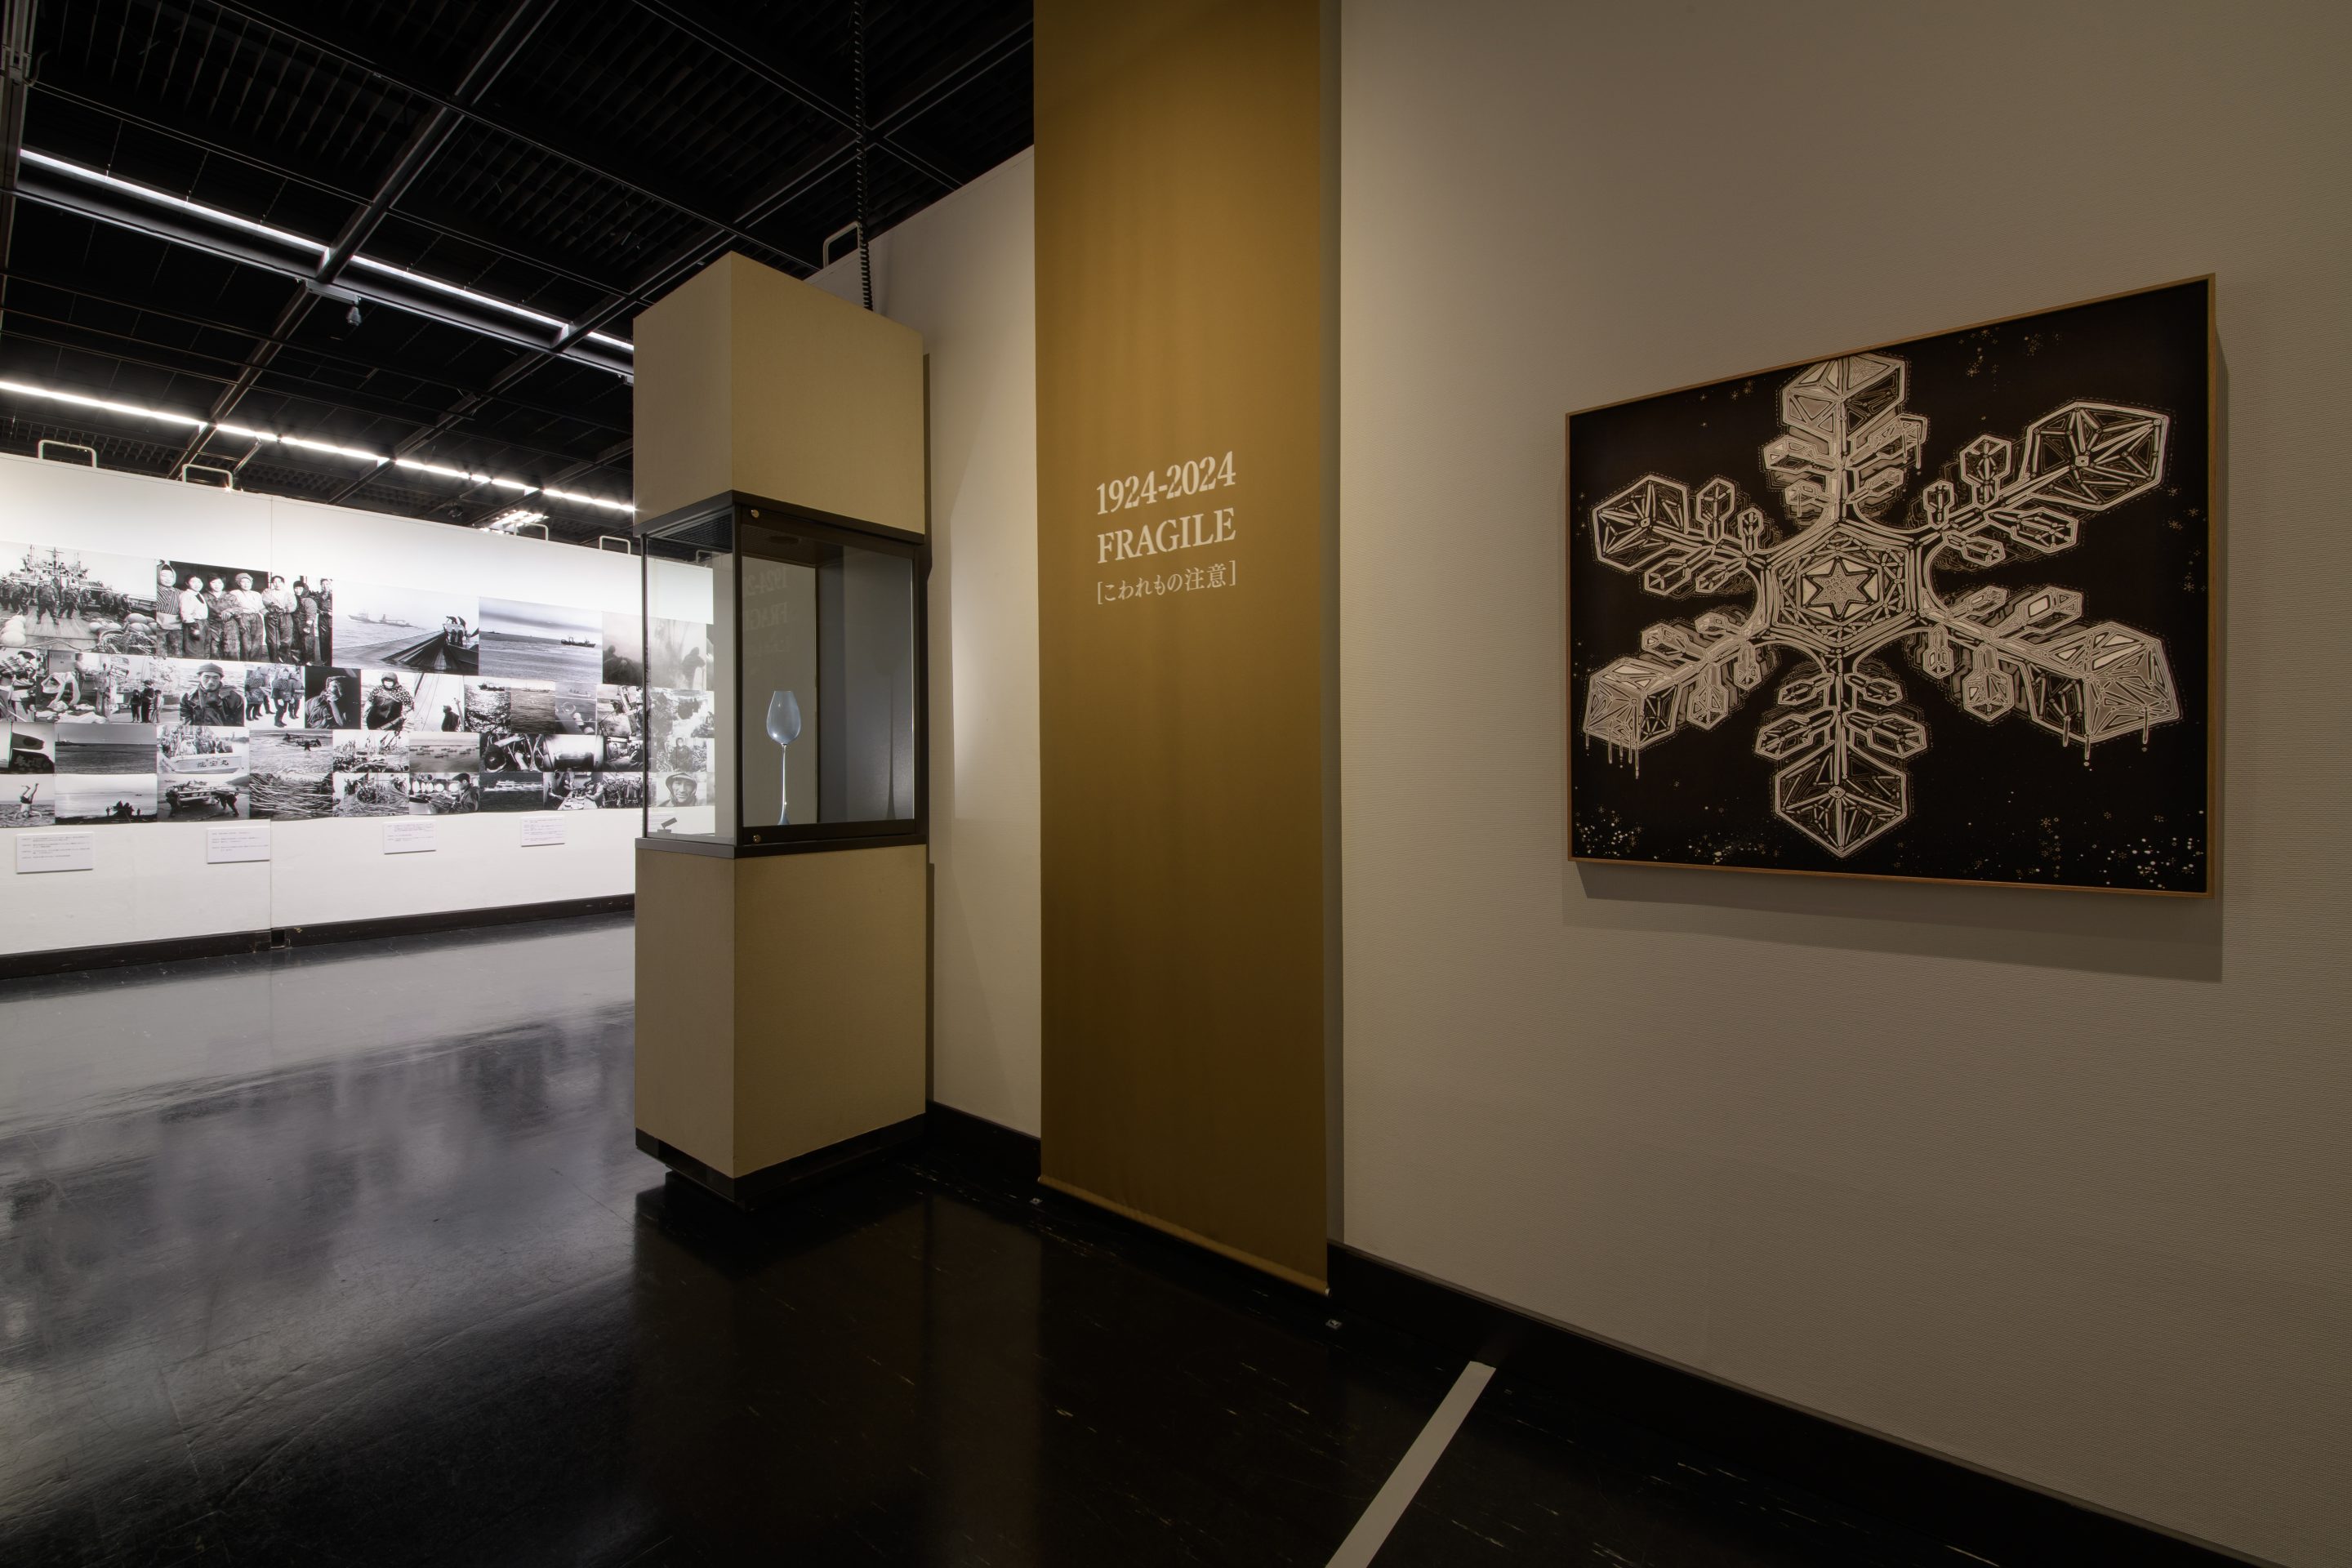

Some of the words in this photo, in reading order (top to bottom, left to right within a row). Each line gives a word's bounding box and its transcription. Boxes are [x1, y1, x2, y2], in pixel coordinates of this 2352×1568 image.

[1097, 451, 1236, 514] 1924-2024
[1098, 507, 1236, 564] FRAGILE
[1098, 560, 1236, 604] [こわれもの注意]
